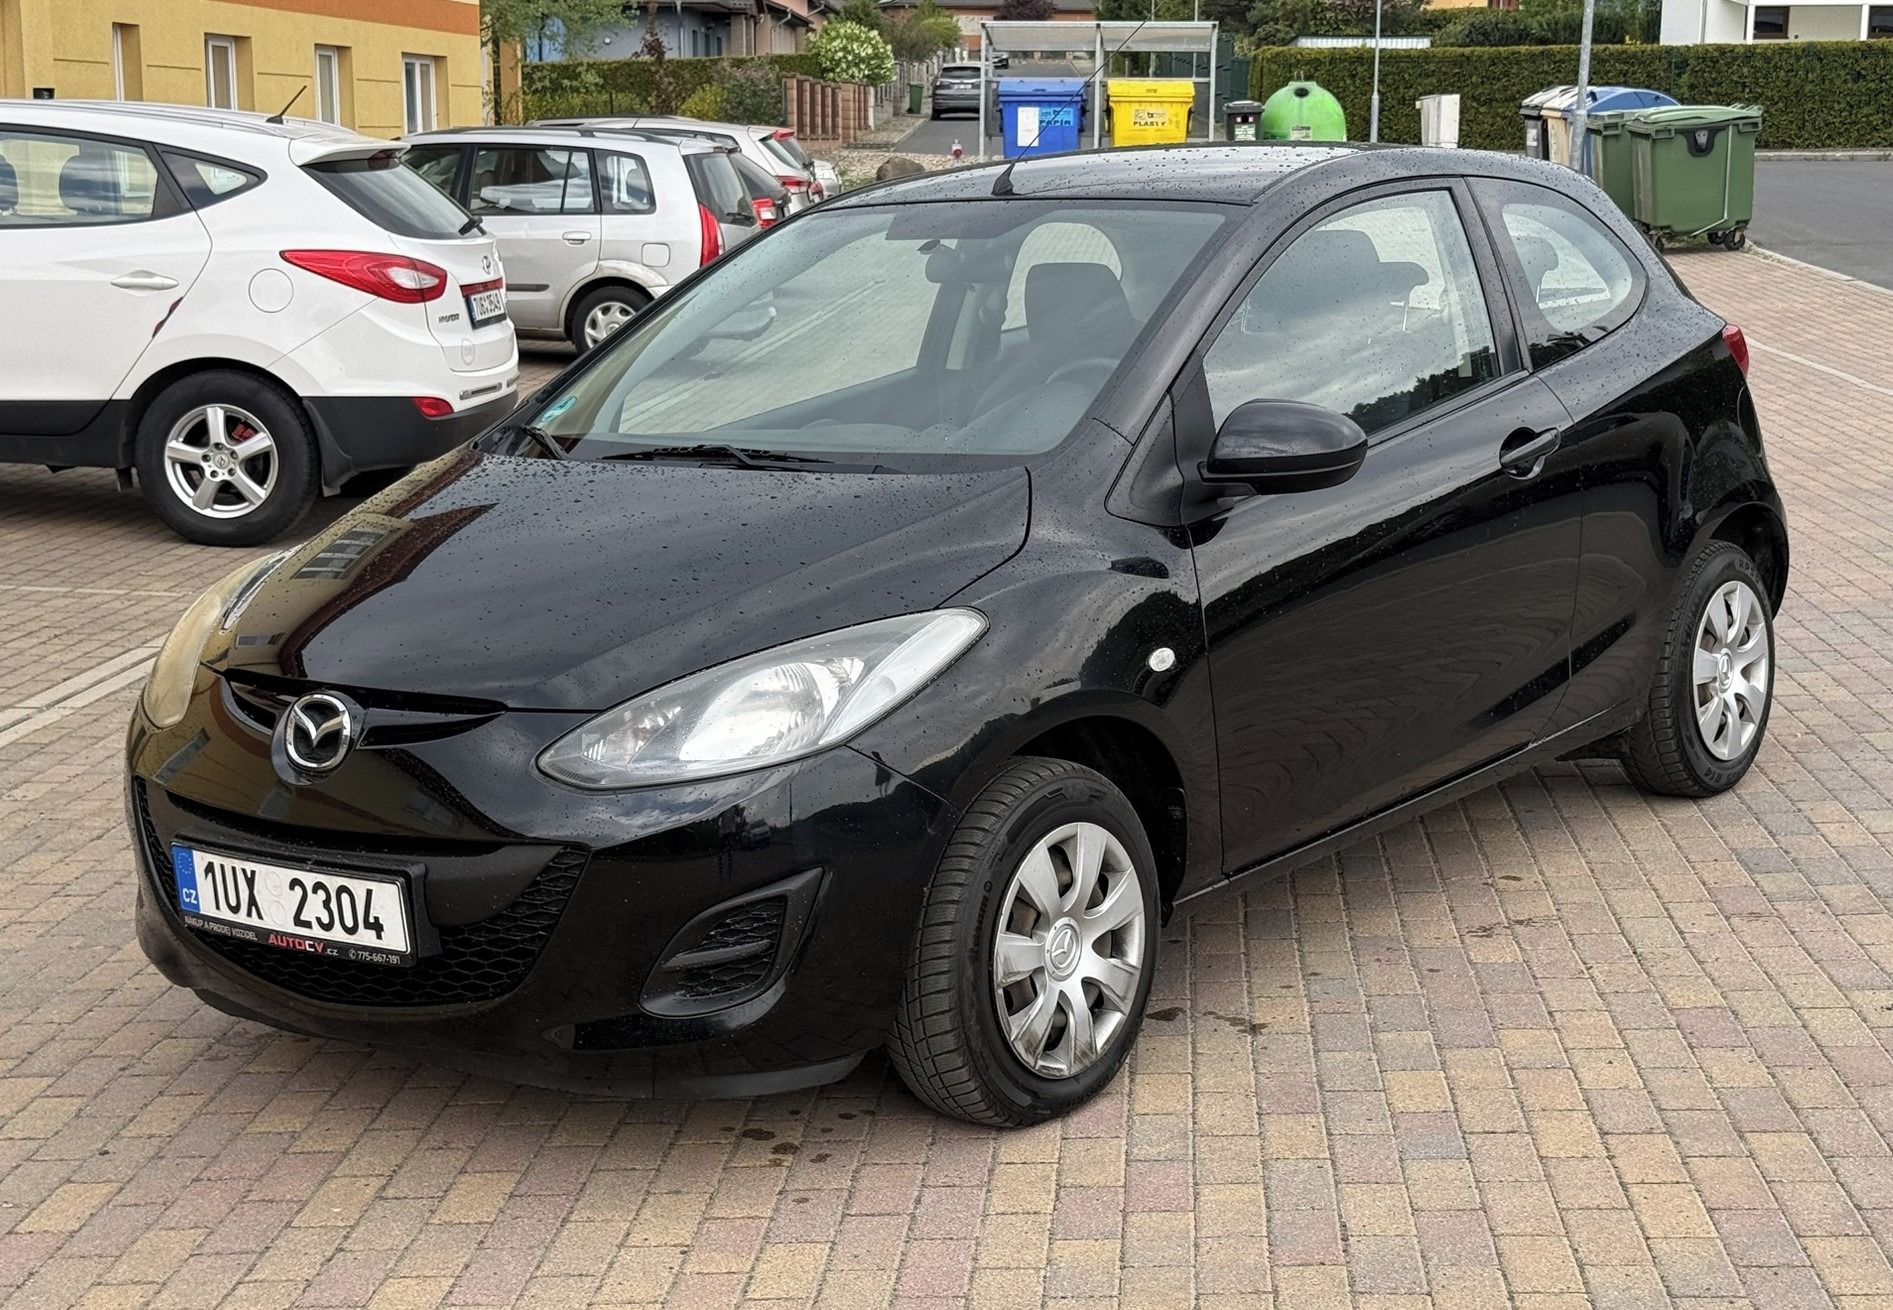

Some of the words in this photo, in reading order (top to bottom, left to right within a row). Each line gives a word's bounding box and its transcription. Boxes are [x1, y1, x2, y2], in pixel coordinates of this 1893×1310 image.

[182, 887, 198, 905] CZ
[204, 861, 264, 920] 1UX
[288, 877, 385, 940] 2304
